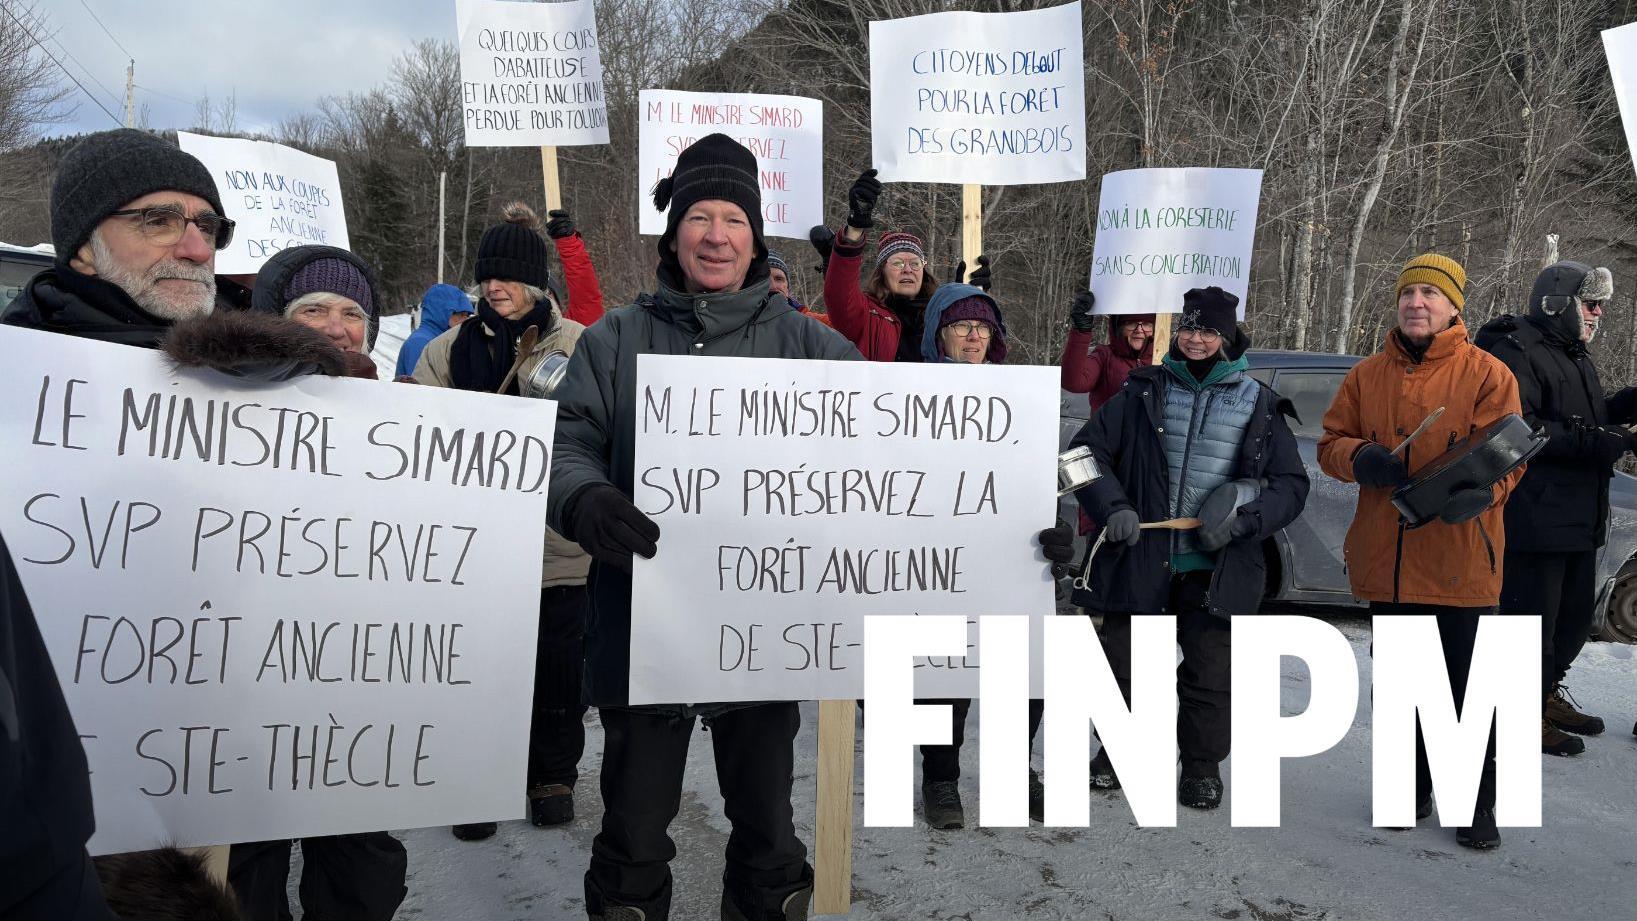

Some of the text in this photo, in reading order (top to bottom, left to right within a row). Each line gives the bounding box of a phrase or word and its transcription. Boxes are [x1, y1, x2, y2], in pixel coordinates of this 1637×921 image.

[478, 28, 596, 52] QUELQUES COUPS
[912, 49, 1007, 76] CITOYENS
[464, 81, 480, 104] ET
[484, 83, 499, 104] LA
[918, 87, 969, 114] POUR
[974, 90, 995, 115] LA
[466, 108, 526, 131] PERDUE
[530, 109, 563, 130] POUR
[671, 101, 686, 124] LE
[690, 104, 744, 126] MINISTRE
[749, 105, 803, 129] SIMARD
[908, 126, 942, 154] DES
[225, 170, 258, 191] NON
[262, 172, 291, 194] AUX
[244, 195, 263, 210] DE
[270, 196, 286, 211] LA
[270, 215, 328, 245] ANCIENNE
[1135, 207, 1151, 230] LA
[1157, 206, 1240, 232] FORESTERIE
[1095, 253, 1241, 279] SANS CONCERTATION
[643, 385, 678, 435] M.
[688, 386, 725, 437] LE
[737, 380, 862, 439] MINISTRE
[31, 375, 88, 451] LE
[117, 381, 343, 477] MINISTRE
[640, 463, 998, 518] SVP PRÉSERVEZ LA
[22, 493, 478, 586] SVP PRÉSERVEZ
[815, 546, 967, 595] ANCIENNE
[73, 600, 472, 686] FORÊT ANCIENNE
[719, 624, 765, 672] DE
[135, 712, 437, 797] STE-THÈCLE
